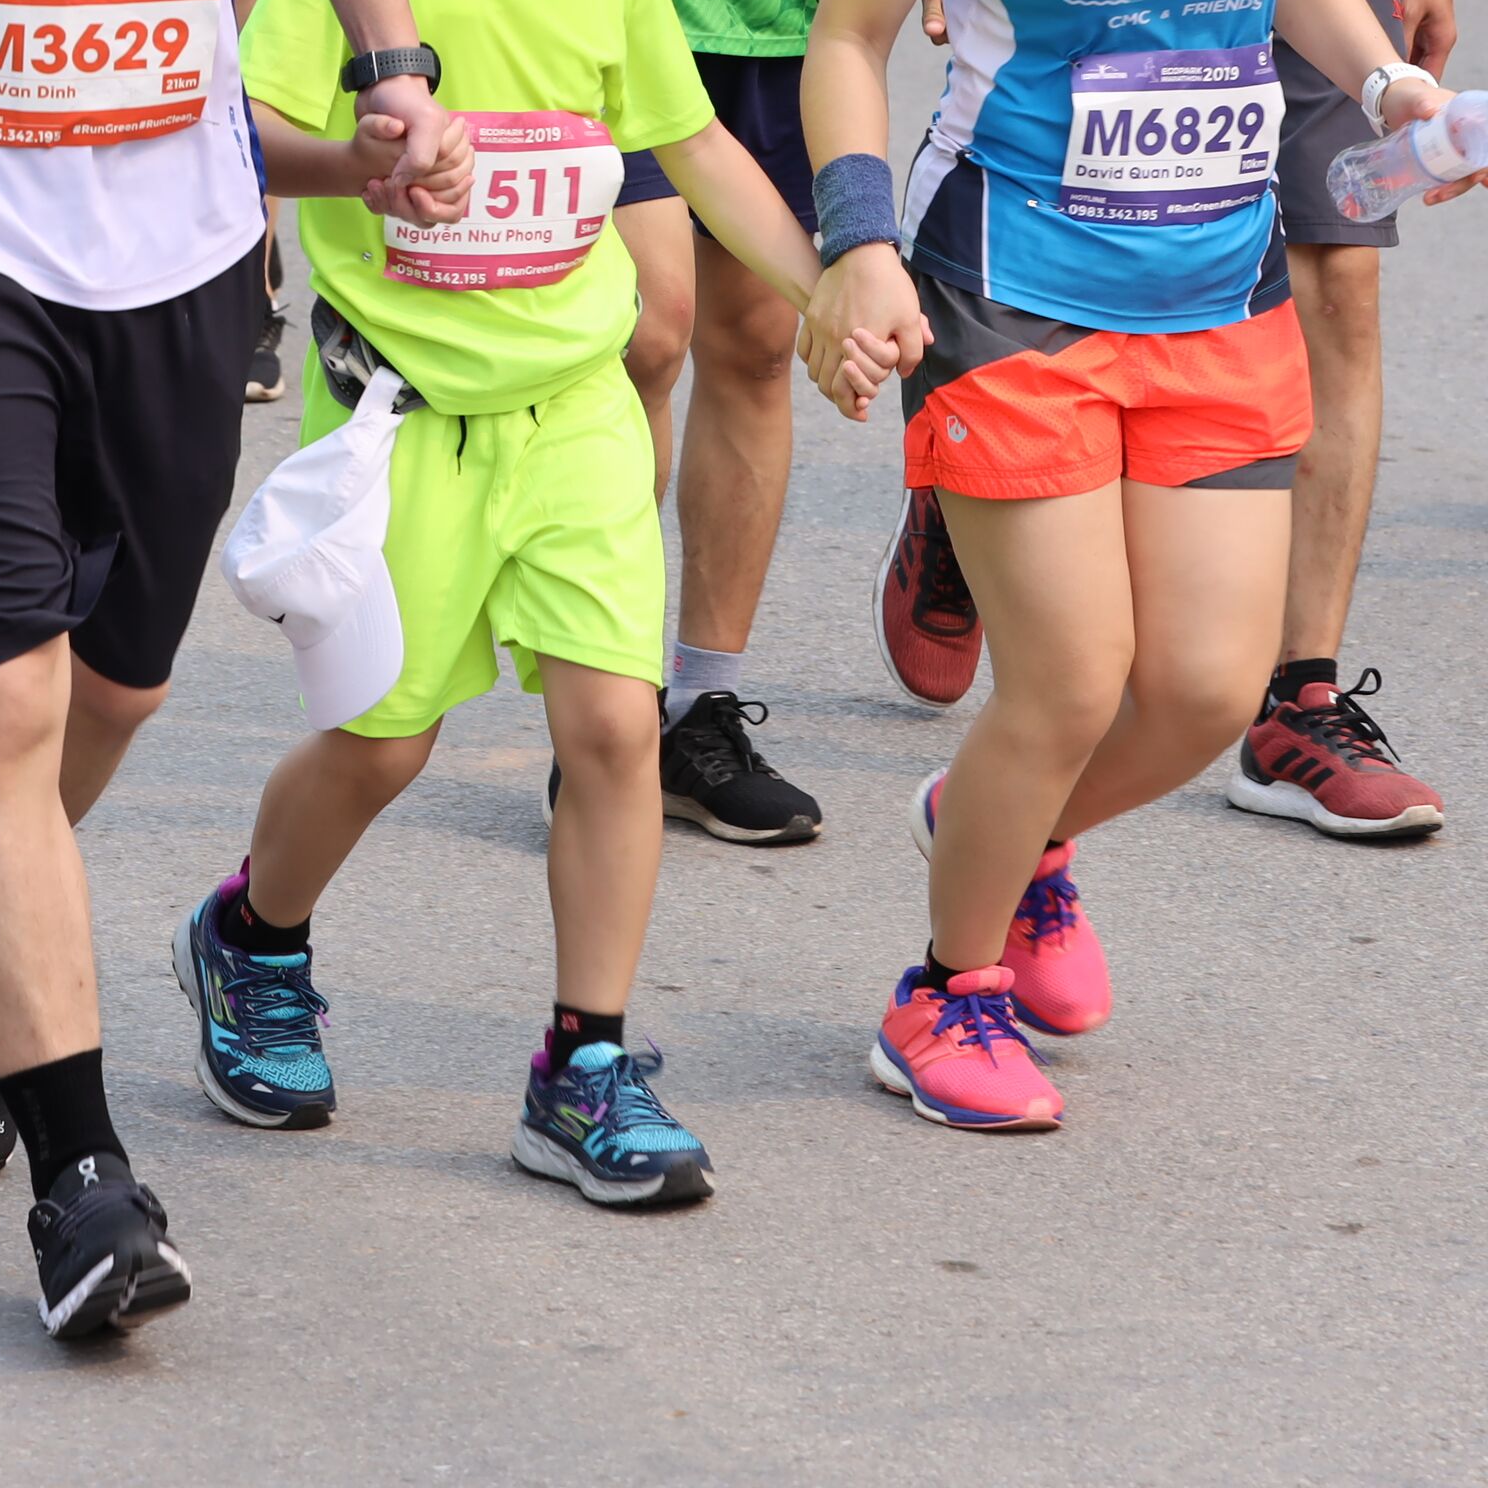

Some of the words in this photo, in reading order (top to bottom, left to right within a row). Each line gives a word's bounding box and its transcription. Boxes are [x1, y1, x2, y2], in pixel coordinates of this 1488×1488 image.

[1107, 10, 1152, 29] CMC
[1202, 65, 1240, 82] 2019
[165, 76, 197, 91] 21km
[37, 85, 77, 100] Dinh
[479, 127, 525, 137] ECOPARK
[524, 126, 562, 144] 2019
[1081, 102, 1265, 157] M6829
[1075, 164, 1124, 180] David
[1129, 165, 1170, 180] Quan
[1175, 165, 1204, 179] Dao
[1070, 194, 1108, 204] HOTLINE
[1068, 204, 1159, 221] 0983.342.195
[396, 225, 462, 244] Nguyễn
[468, 229, 503, 243] Như
[506, 229, 553, 244] Phong
[580, 223, 602, 234] 5km
[396, 263, 487, 285] 0983.342.195
